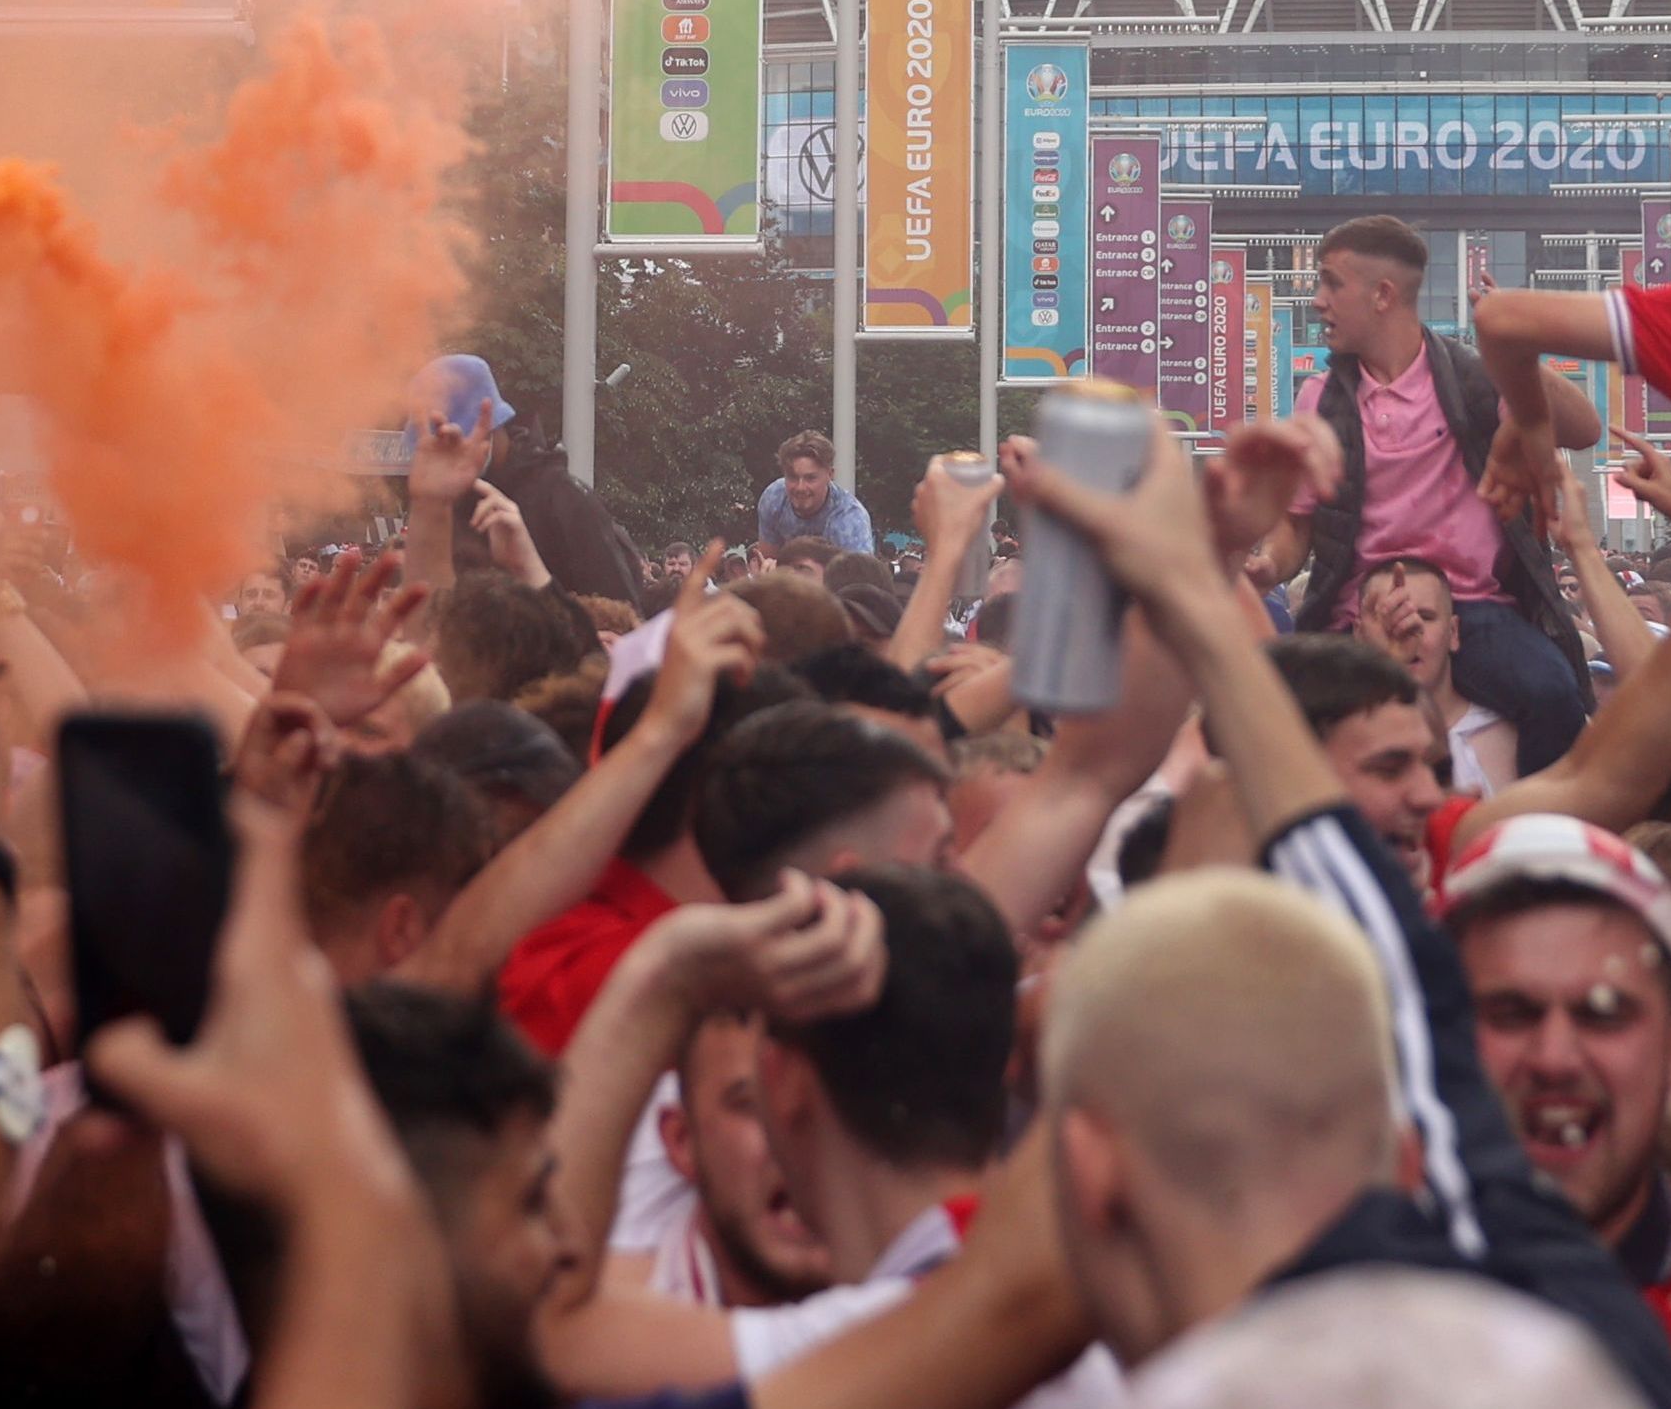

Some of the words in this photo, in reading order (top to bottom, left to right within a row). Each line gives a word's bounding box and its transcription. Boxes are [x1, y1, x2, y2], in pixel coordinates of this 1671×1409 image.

[675, 57, 706, 67] TikTok
[669, 88, 701, 98] vivo
[906, 84, 932, 172] EURO
[1309, 121, 1478, 171] EURO
[1488, 121, 1647, 171] 2020
[905, 176, 932, 262] UEFA
[1096, 233, 1138, 241] Entrance
[1096, 251, 1138, 259] Entrance
[1096, 269, 1138, 277] Entrance
[1214, 295, 1227, 337] 2020
[1096, 325, 1138, 333] Entrance
[1096, 342, 1138, 350] Entrance
[1214, 340, 1227, 376] EURO
[1214, 376, 1227, 418] UEFA
